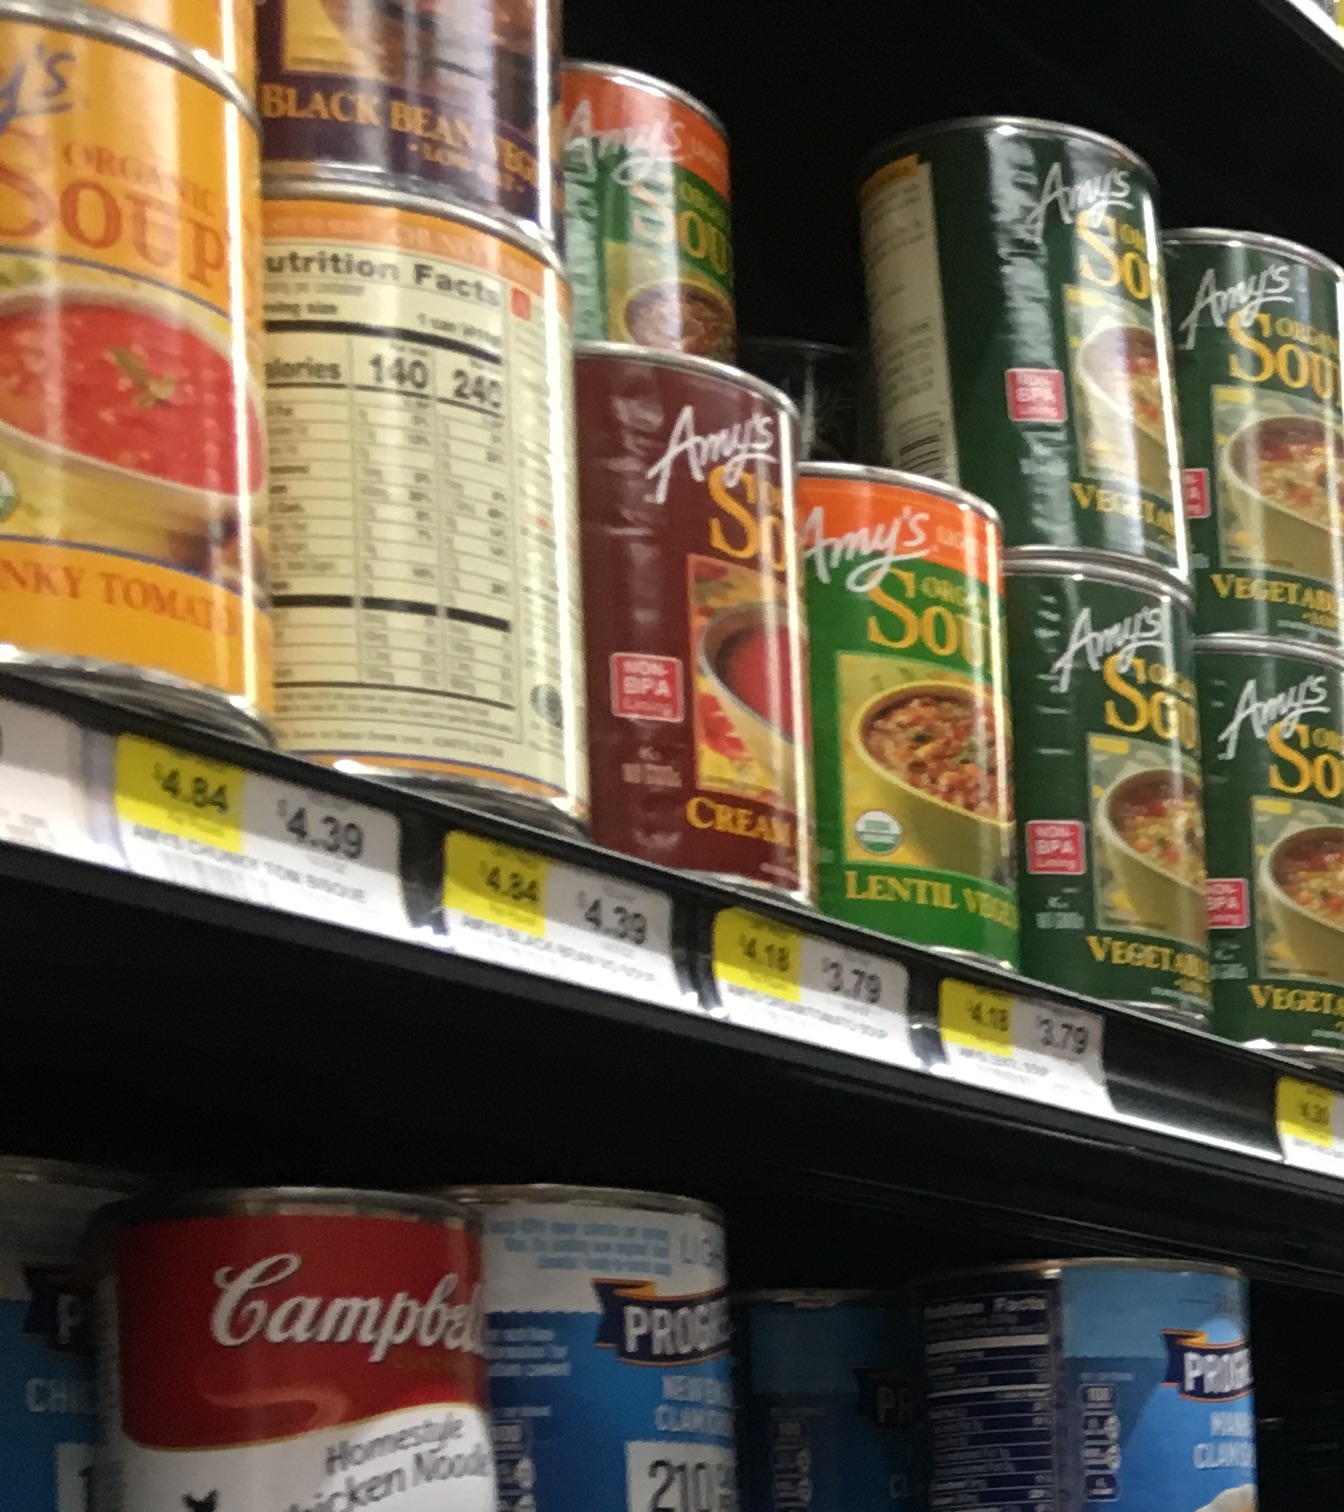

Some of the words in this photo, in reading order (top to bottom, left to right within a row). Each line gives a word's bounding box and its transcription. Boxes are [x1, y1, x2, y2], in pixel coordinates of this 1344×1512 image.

[260, 83, 380, 126] BLACK
[390, 101, 473, 148] BEAN
[562, 98, 686, 185] Amy's
[1016, 161, 1133, 241] Amy's
[264, 251, 400, 281] utrition
[413, 262, 501, 308] Facts
[1179, 264, 1296, 351] Amy's
[369, 353, 430, 391] 140
[647, 405, 779, 504] Amy's
[800, 504, 931, 592] Amy's
[1050, 606, 1166, 695] Amy's
[1217, 677, 1330, 761] Amy's
[844, 870, 957, 907] LENTIL
[323, 1413, 466, 1478] Homestyle
